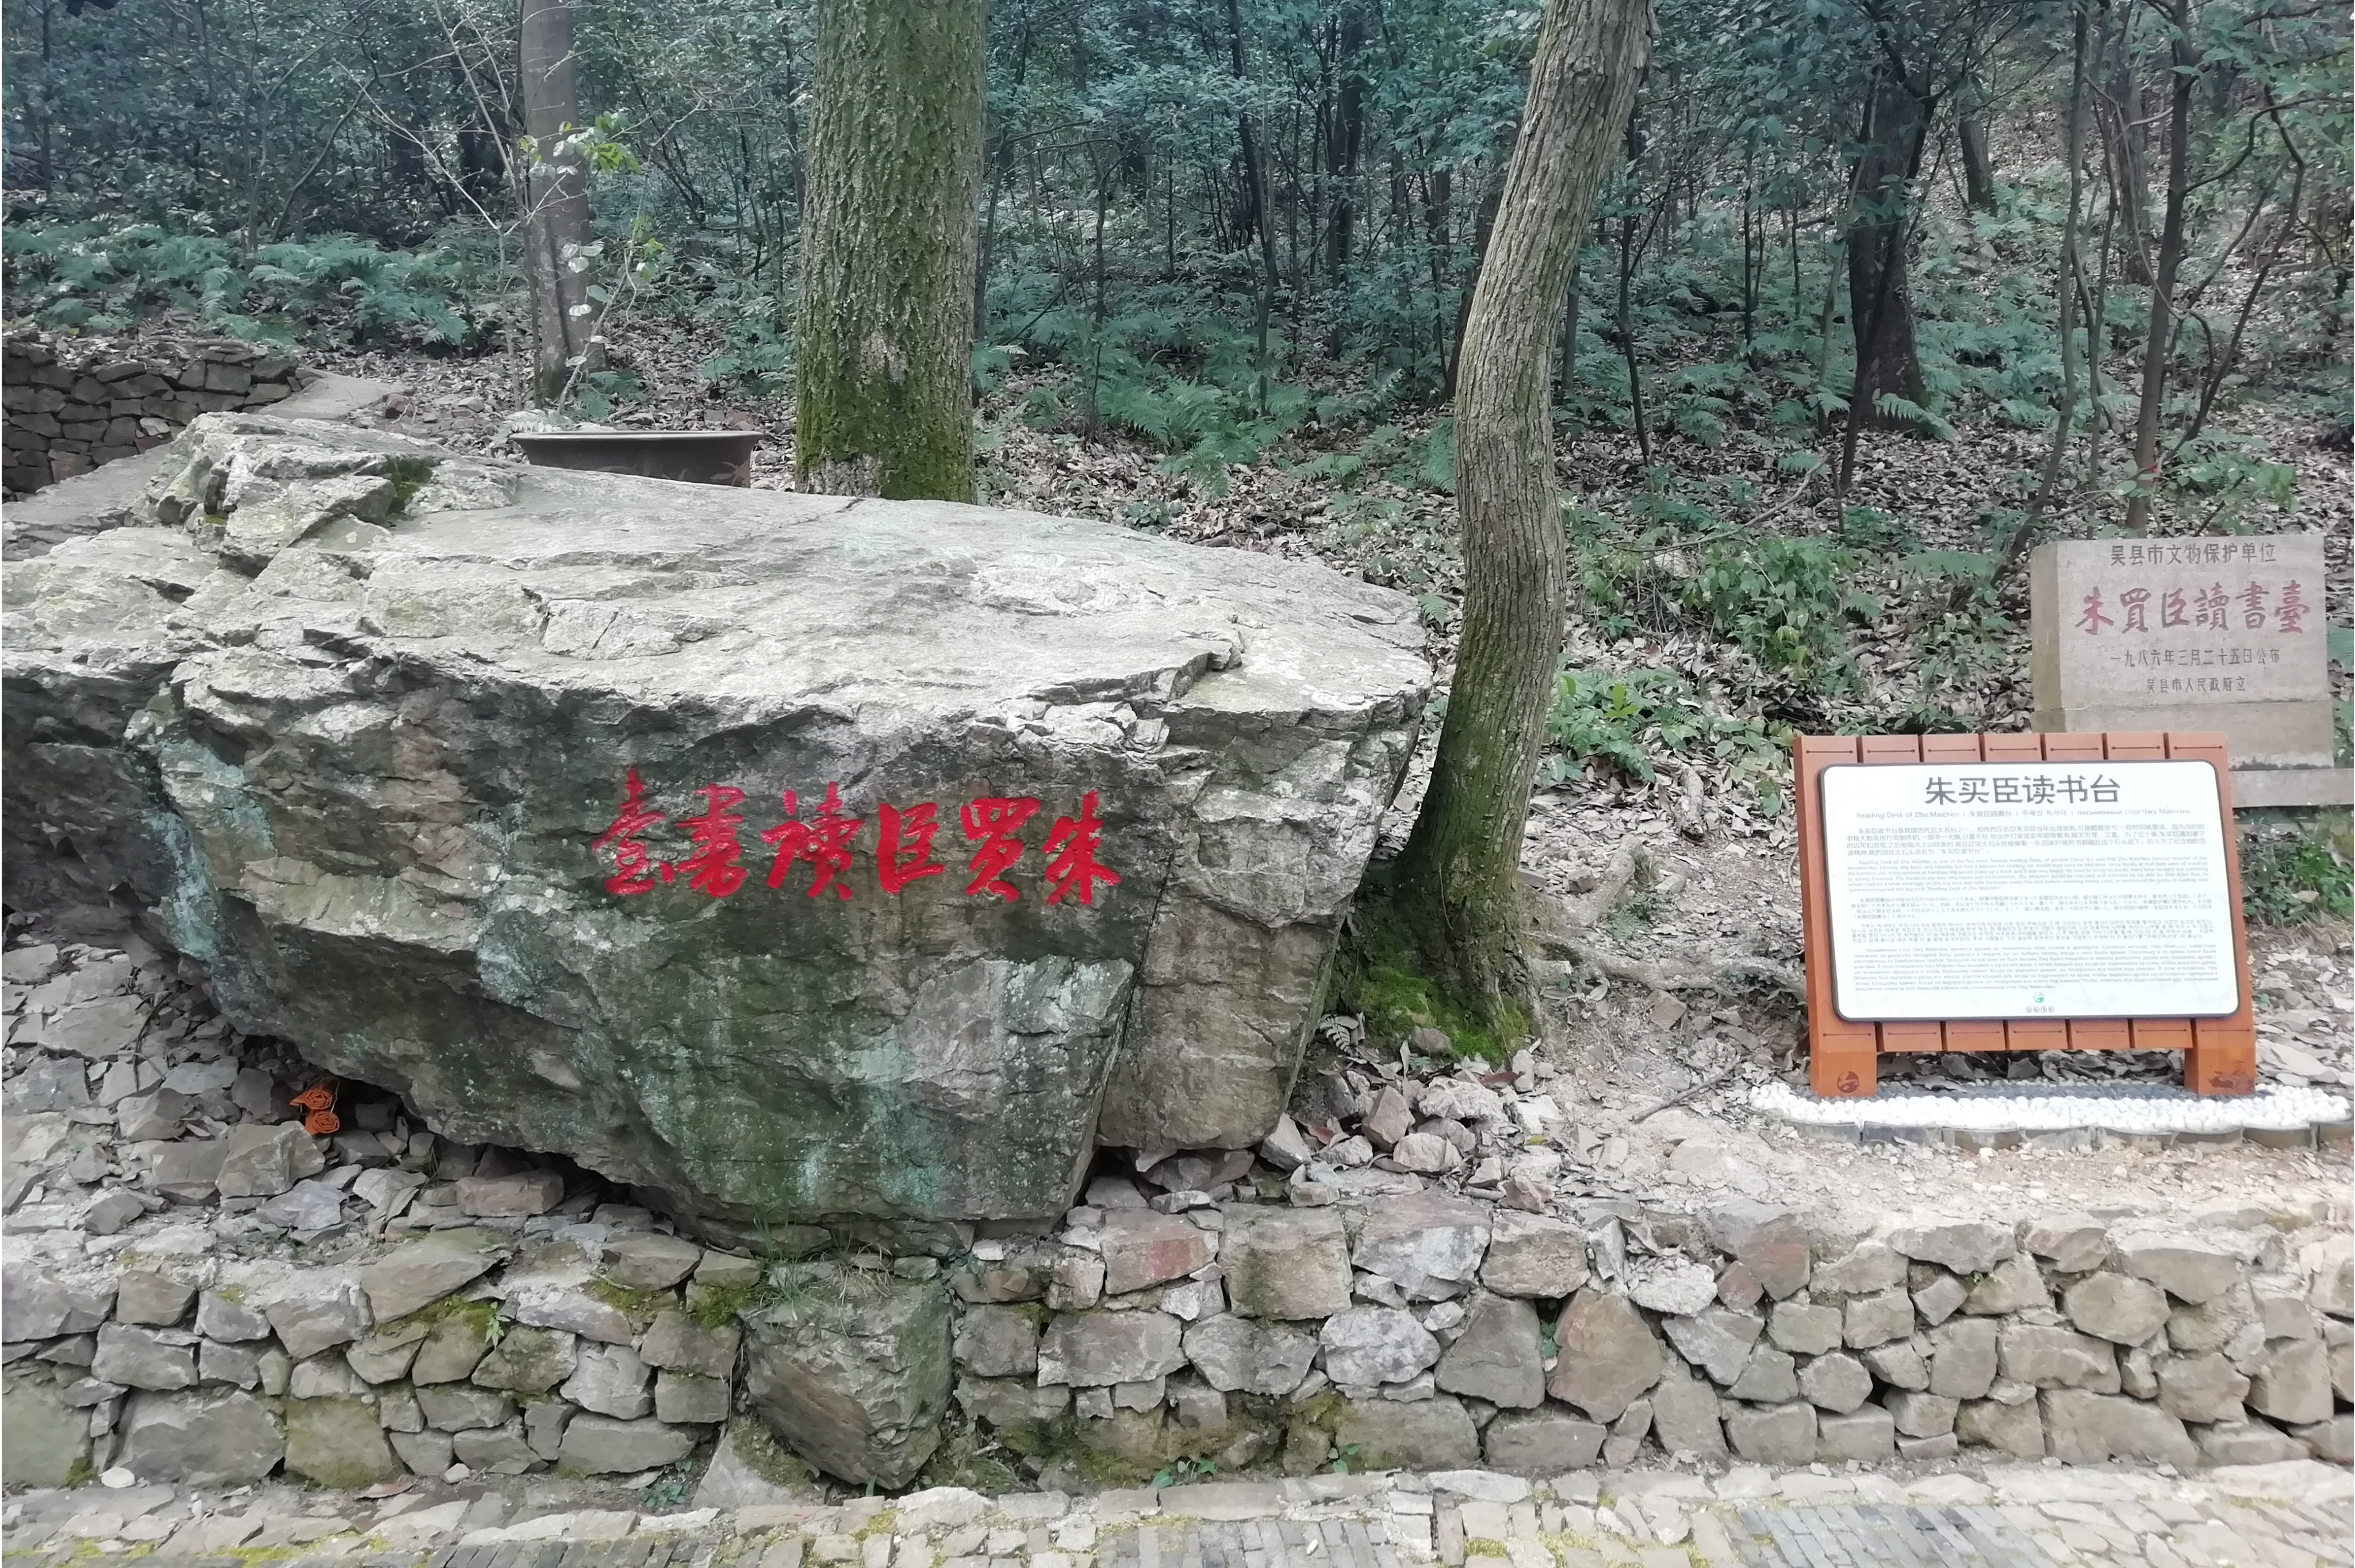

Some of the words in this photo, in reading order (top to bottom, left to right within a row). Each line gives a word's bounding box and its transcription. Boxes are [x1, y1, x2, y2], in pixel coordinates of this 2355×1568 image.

[2111, 543, 2276, 566] 吴县市文物保护单位
[2075, 579, 2310, 635] 朱買臣讀書臺
[2111, 648, 2280, 667] 一九八六年三月二十五日公布
[2147, 676, 2246, 694] 吴县市人民政府立
[1924, 774, 2121, 805] 朱买臣读书台
